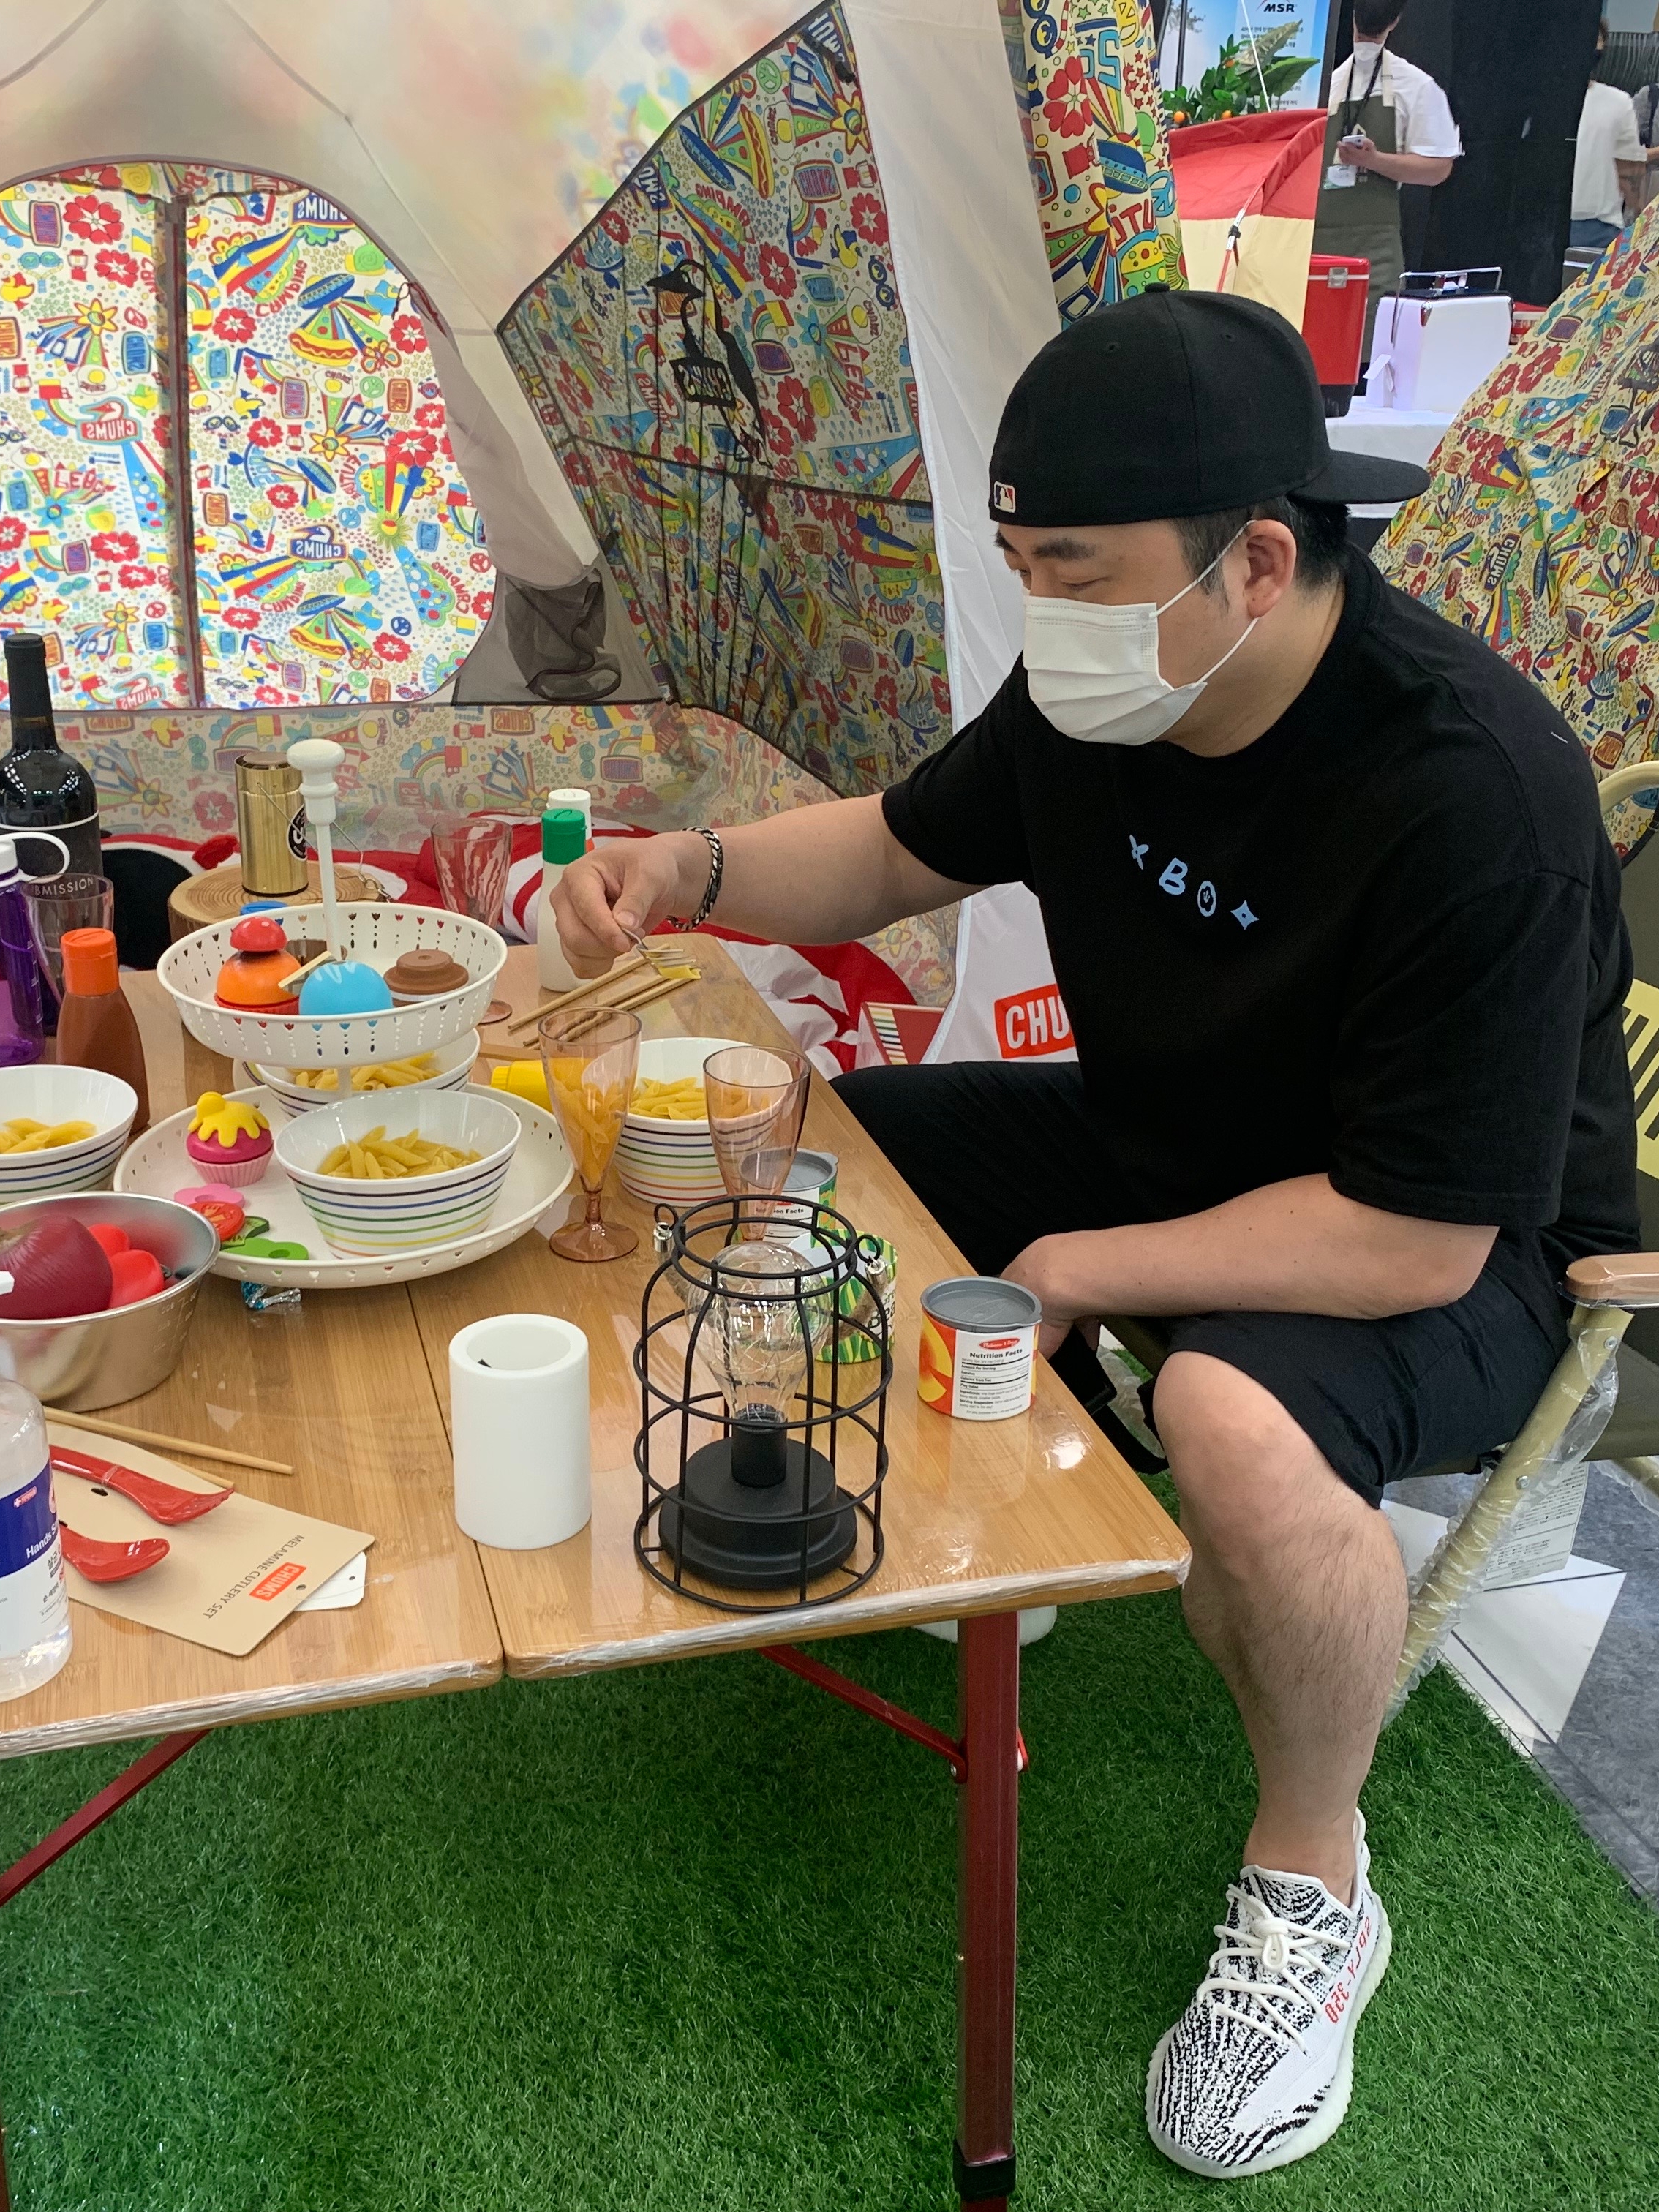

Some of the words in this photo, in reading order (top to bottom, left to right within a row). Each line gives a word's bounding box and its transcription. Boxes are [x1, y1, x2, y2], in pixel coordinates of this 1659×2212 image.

[1264, 4, 1295, 12] MSR
[1006, 995, 1069, 1050] CHU
[1005, 1349, 1023, 1357] Facts
[26, 1530, 52, 1559] Hands
[260, 1535, 304, 1571] MELAMINE
[224, 1570, 260, 1604] CUTLERY
[256, 1565, 301, 1598] CHUMS
[203, 1603, 223, 1619] SET
